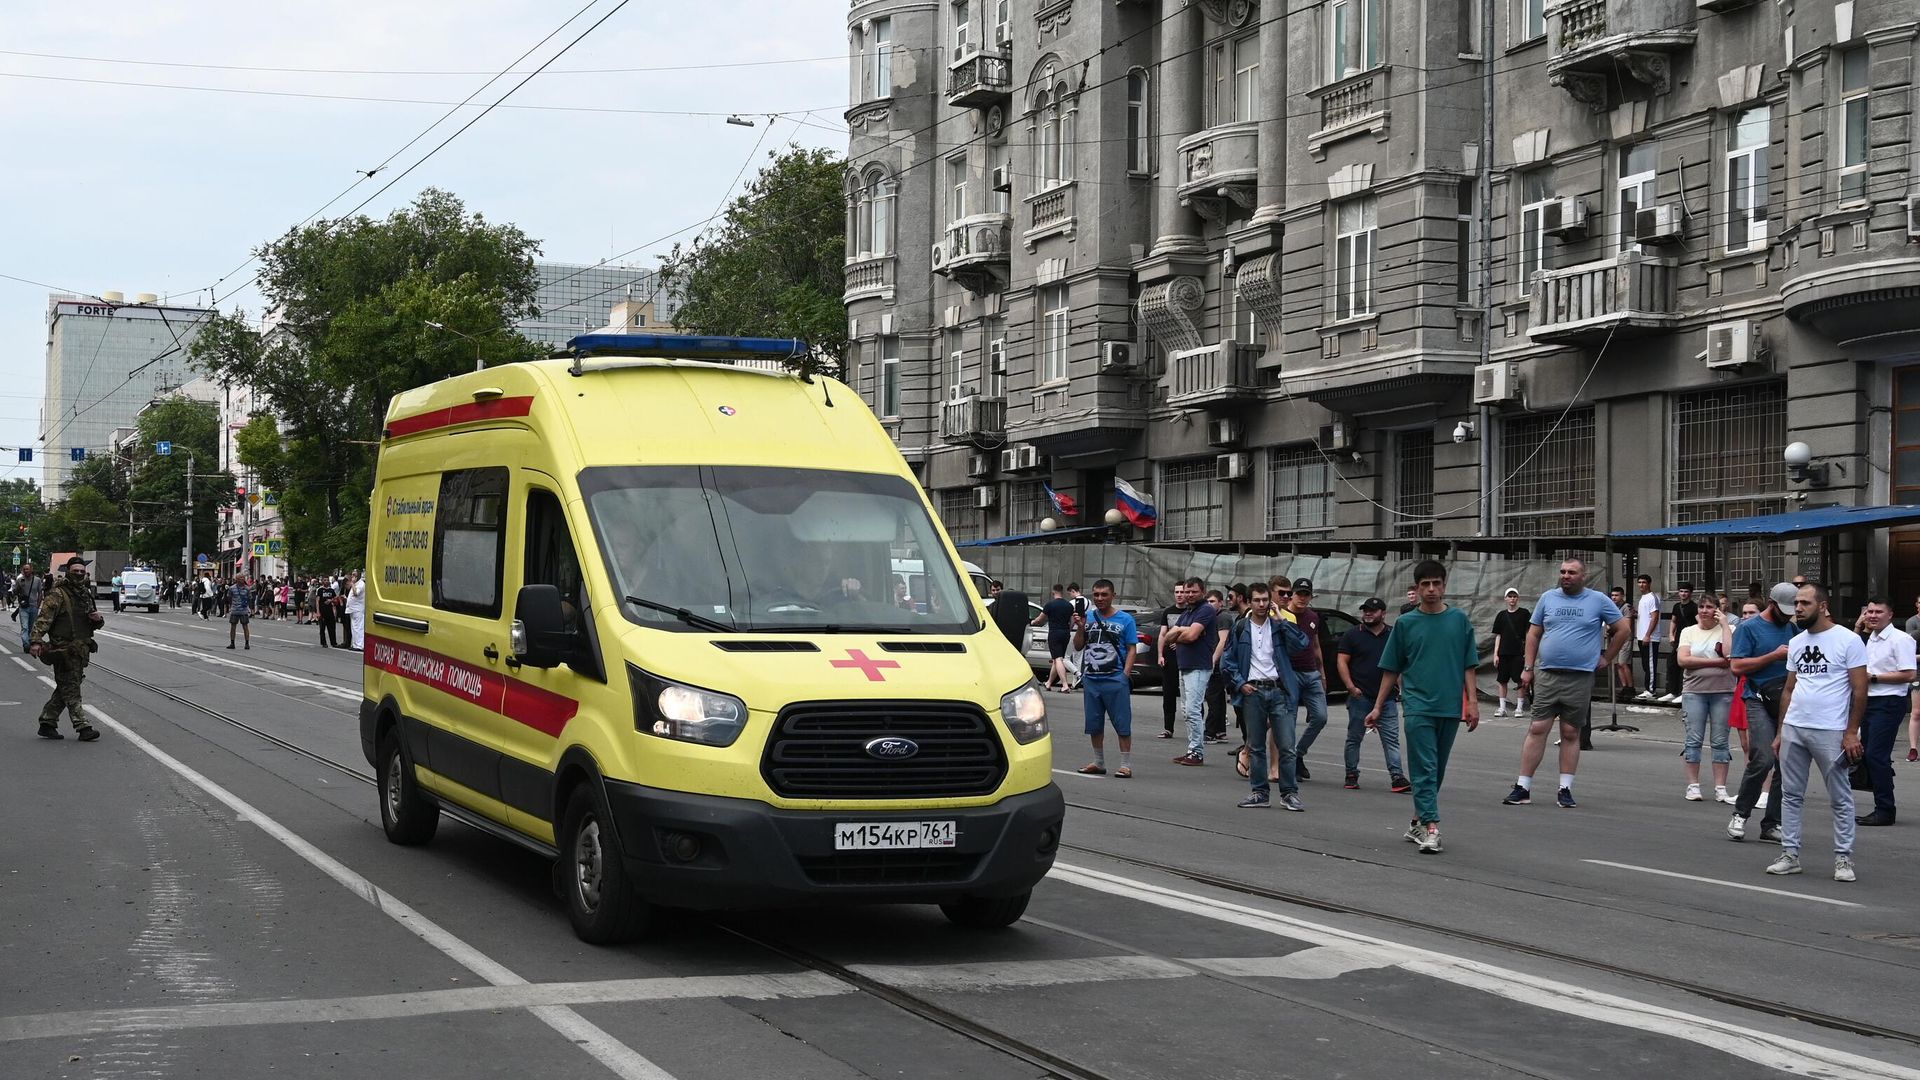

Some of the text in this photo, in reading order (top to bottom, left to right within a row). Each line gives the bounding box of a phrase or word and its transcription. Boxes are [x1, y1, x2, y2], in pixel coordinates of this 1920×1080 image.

[77, 305, 114, 316] FORTE
[392, 496, 435, 517] Стабильный врач
[374, 642, 483, 699] СКОРАЯ МЕДИЦИНСКАЯ ПОМОЩЬ
[1796, 663, 1828, 675] Kappa
[880, 741, 908, 755] Ford
[922, 822, 950, 840] 761
